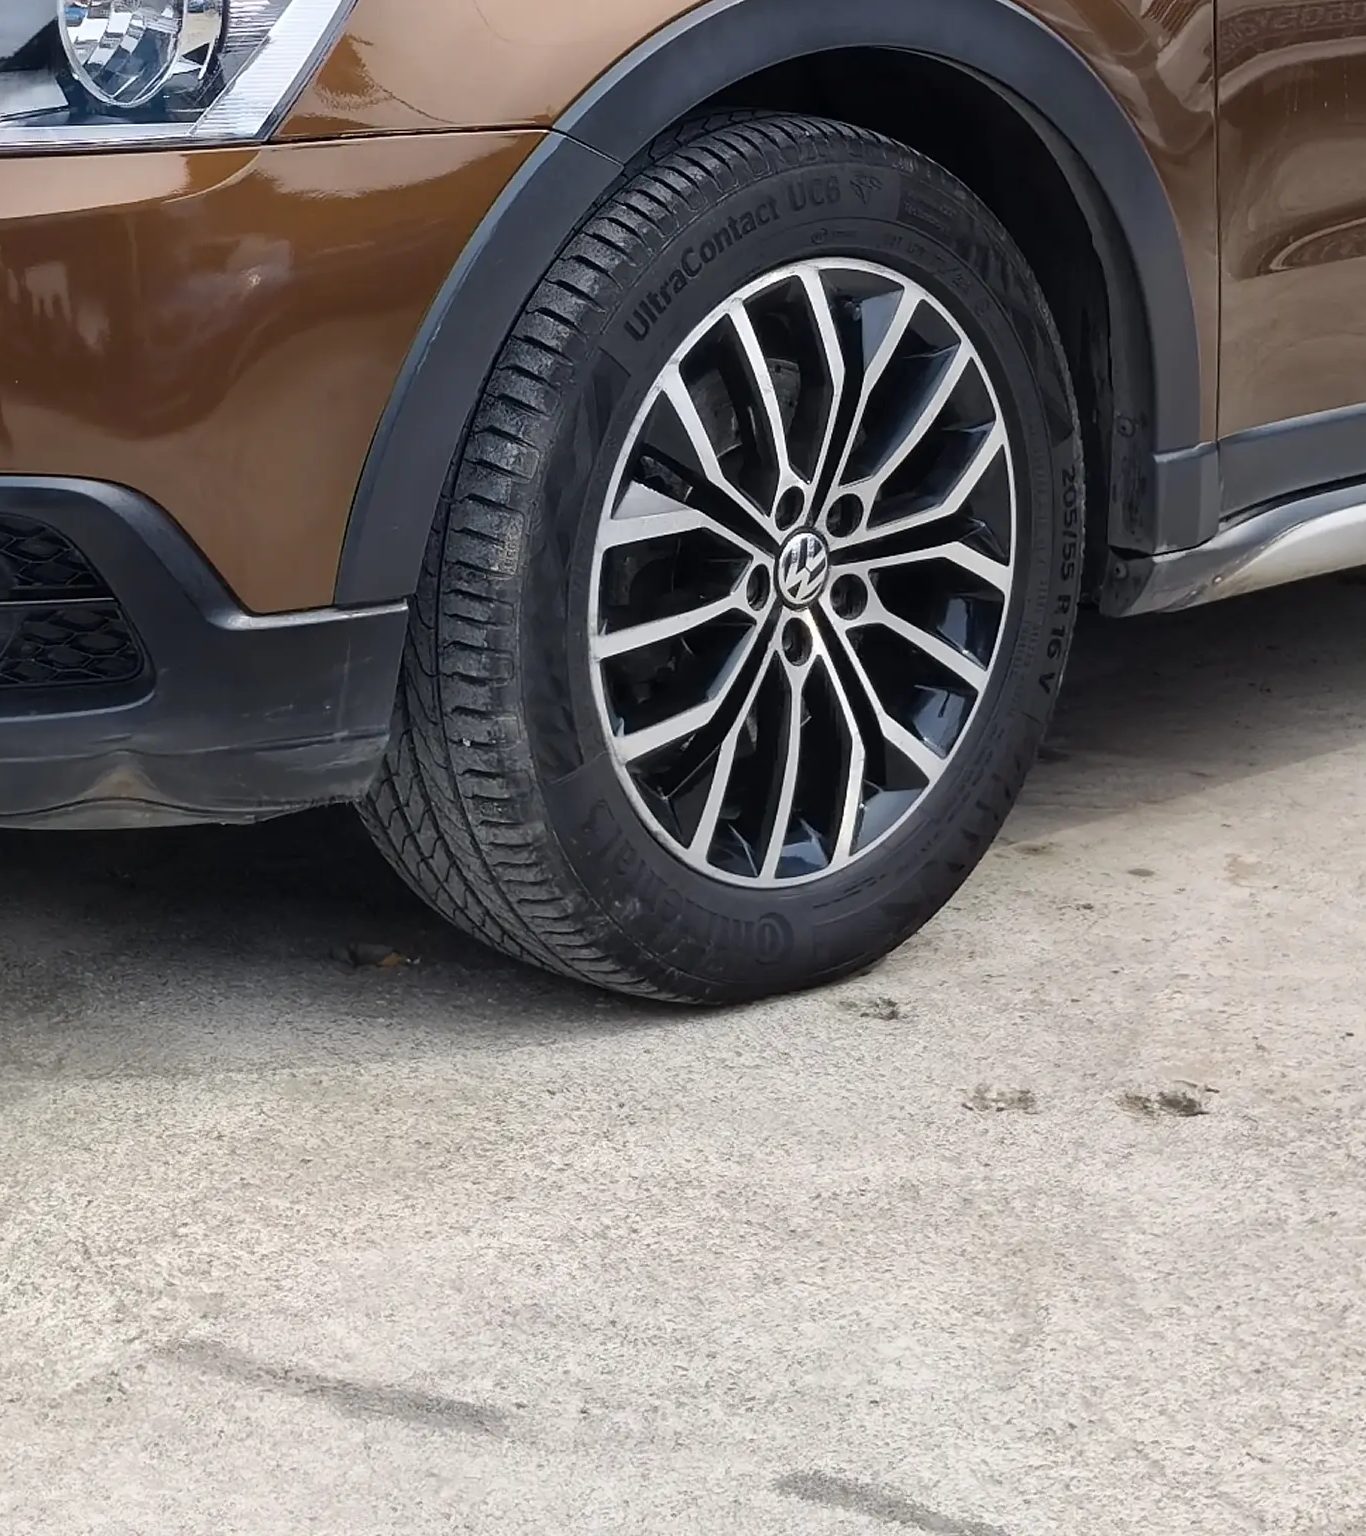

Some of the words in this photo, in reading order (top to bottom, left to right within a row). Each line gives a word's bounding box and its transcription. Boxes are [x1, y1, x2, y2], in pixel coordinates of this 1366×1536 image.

[623, 194, 780, 343] UltraContact
[788, 175, 841, 212] UC6
[1057, 465, 1079, 582] 205/55
[1052, 593, 1073, 616] R
[1046, 625, 1067, 660] 16
[1037, 670, 1057, 696] V
